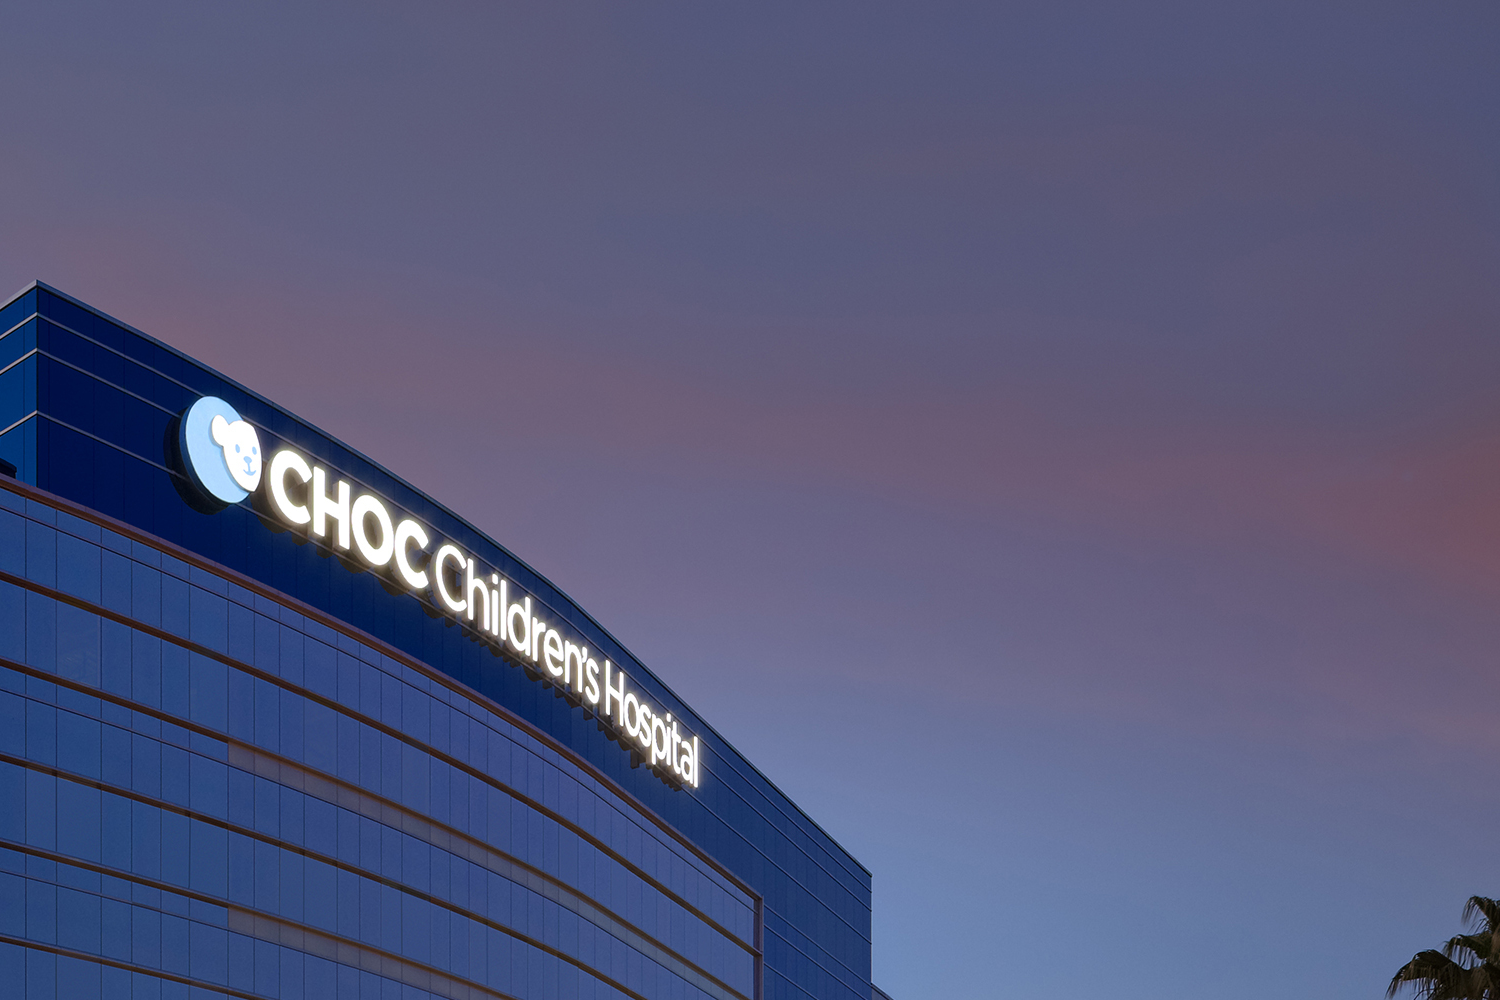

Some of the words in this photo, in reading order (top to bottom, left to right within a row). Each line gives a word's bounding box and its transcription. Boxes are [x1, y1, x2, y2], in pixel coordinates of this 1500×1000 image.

[269, 449, 429, 589] CHOC
[435, 544, 601, 705] Children's
[604, 659, 699, 788] Hospital
